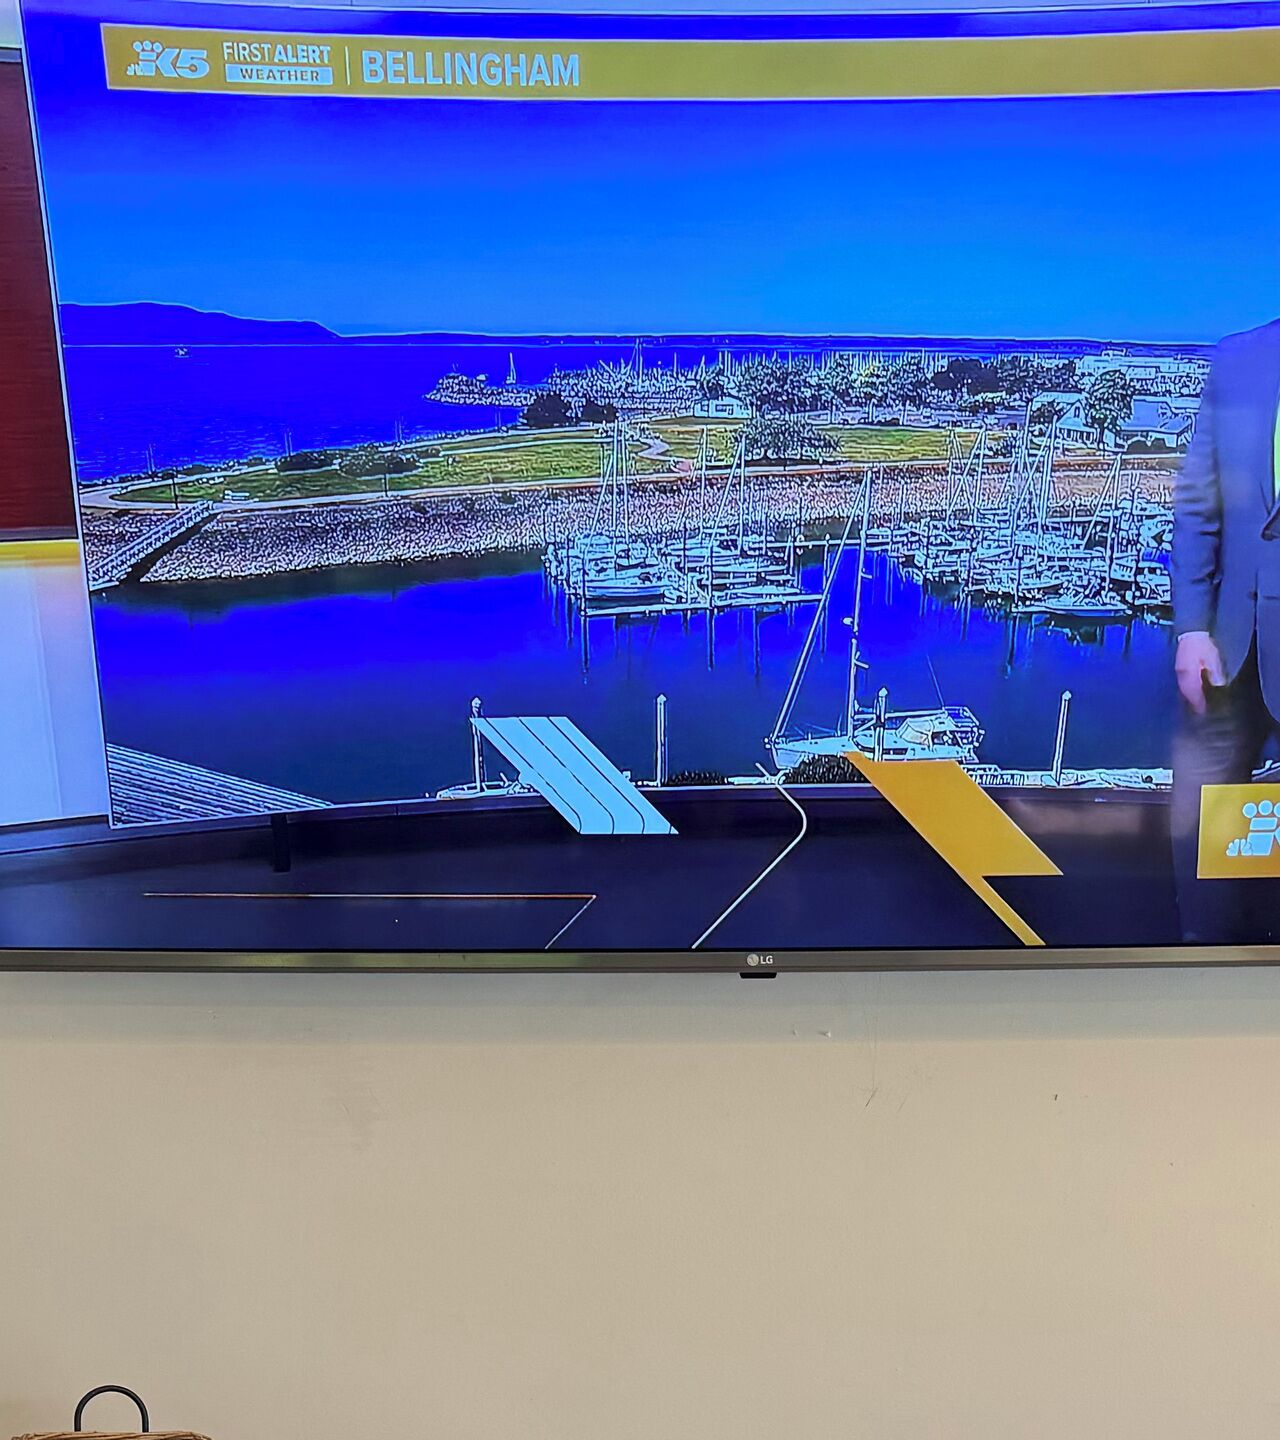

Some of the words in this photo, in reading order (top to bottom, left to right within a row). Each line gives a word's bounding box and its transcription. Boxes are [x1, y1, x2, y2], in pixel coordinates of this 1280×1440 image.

[240, 67, 320, 83] WEATHER
[361, 49, 579, 86] BELLINGHAM
[760, 955, 774, 965] LG
